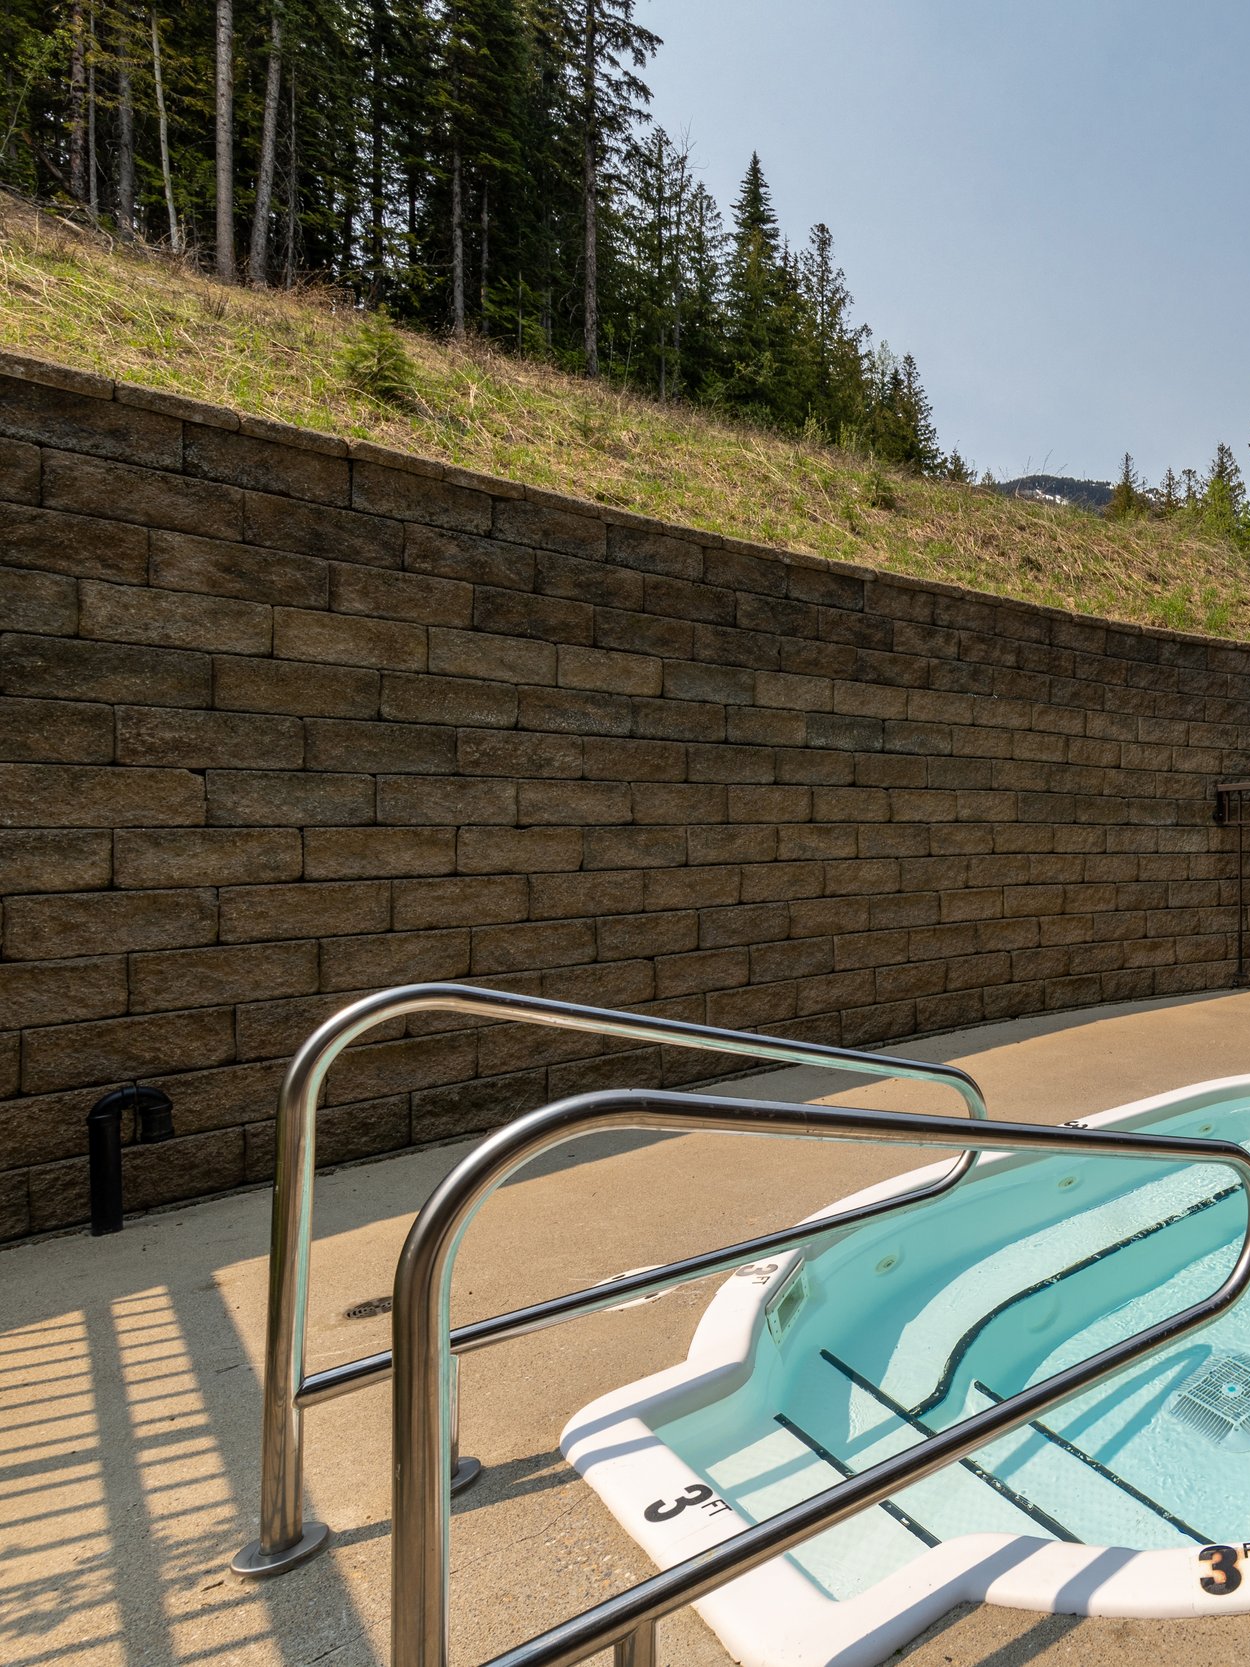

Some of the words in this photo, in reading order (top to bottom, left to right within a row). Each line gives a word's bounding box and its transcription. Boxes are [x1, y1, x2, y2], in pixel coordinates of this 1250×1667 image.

[735, 1264, 778, 1277] 3
[751, 1276, 770, 1285] FT
[644, 1483, 714, 1523] 3
[701, 1499, 732, 1517] FT
[1198, 1545, 1242, 1596] 3
